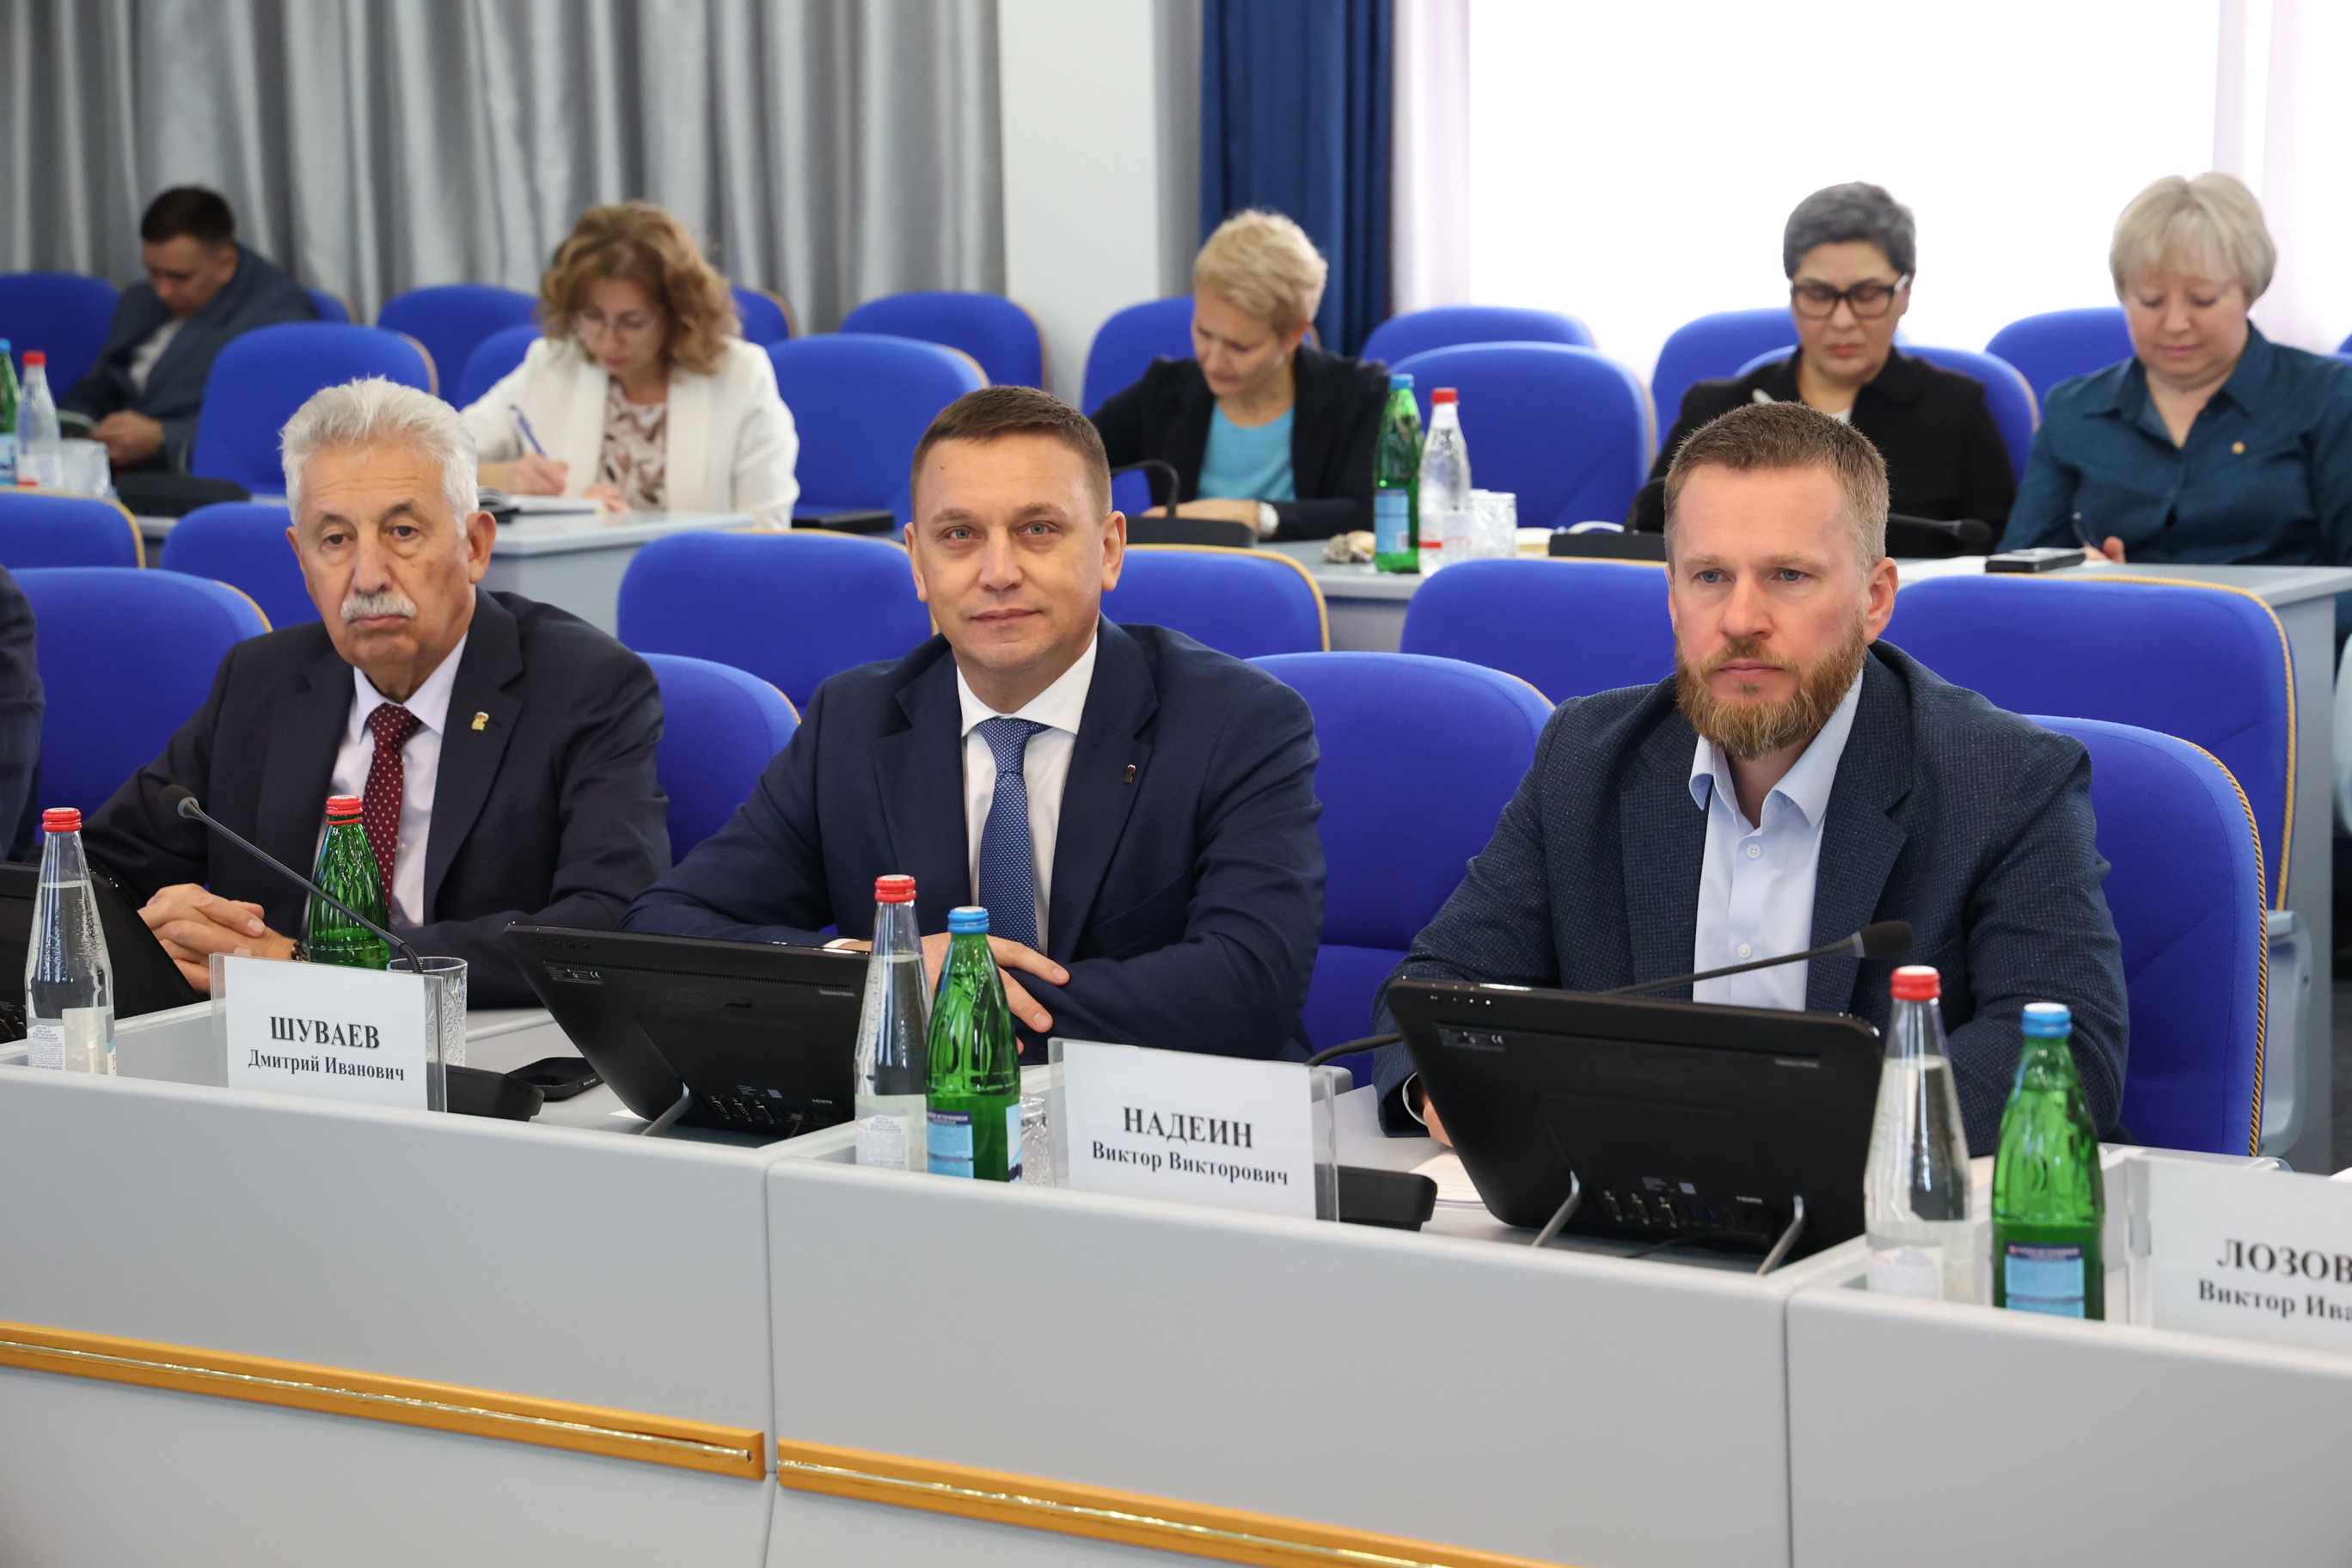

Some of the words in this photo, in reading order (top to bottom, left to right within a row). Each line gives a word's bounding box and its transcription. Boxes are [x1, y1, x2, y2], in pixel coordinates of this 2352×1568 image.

[269, 1015, 381, 1050] ШУВАЕВ
[248, 1049, 320, 1075] Дмитрий
[324, 1056, 405, 1081] Иванович
[1123, 1106, 1253, 1148] НАДЕИН
[1092, 1140, 1162, 1173] Виктор
[1168, 1150, 1289, 1186] Викторович
[2216, 1238, 2352, 1284] ЛОЗОВ
[2198, 1279, 2296, 1319] Виктор
